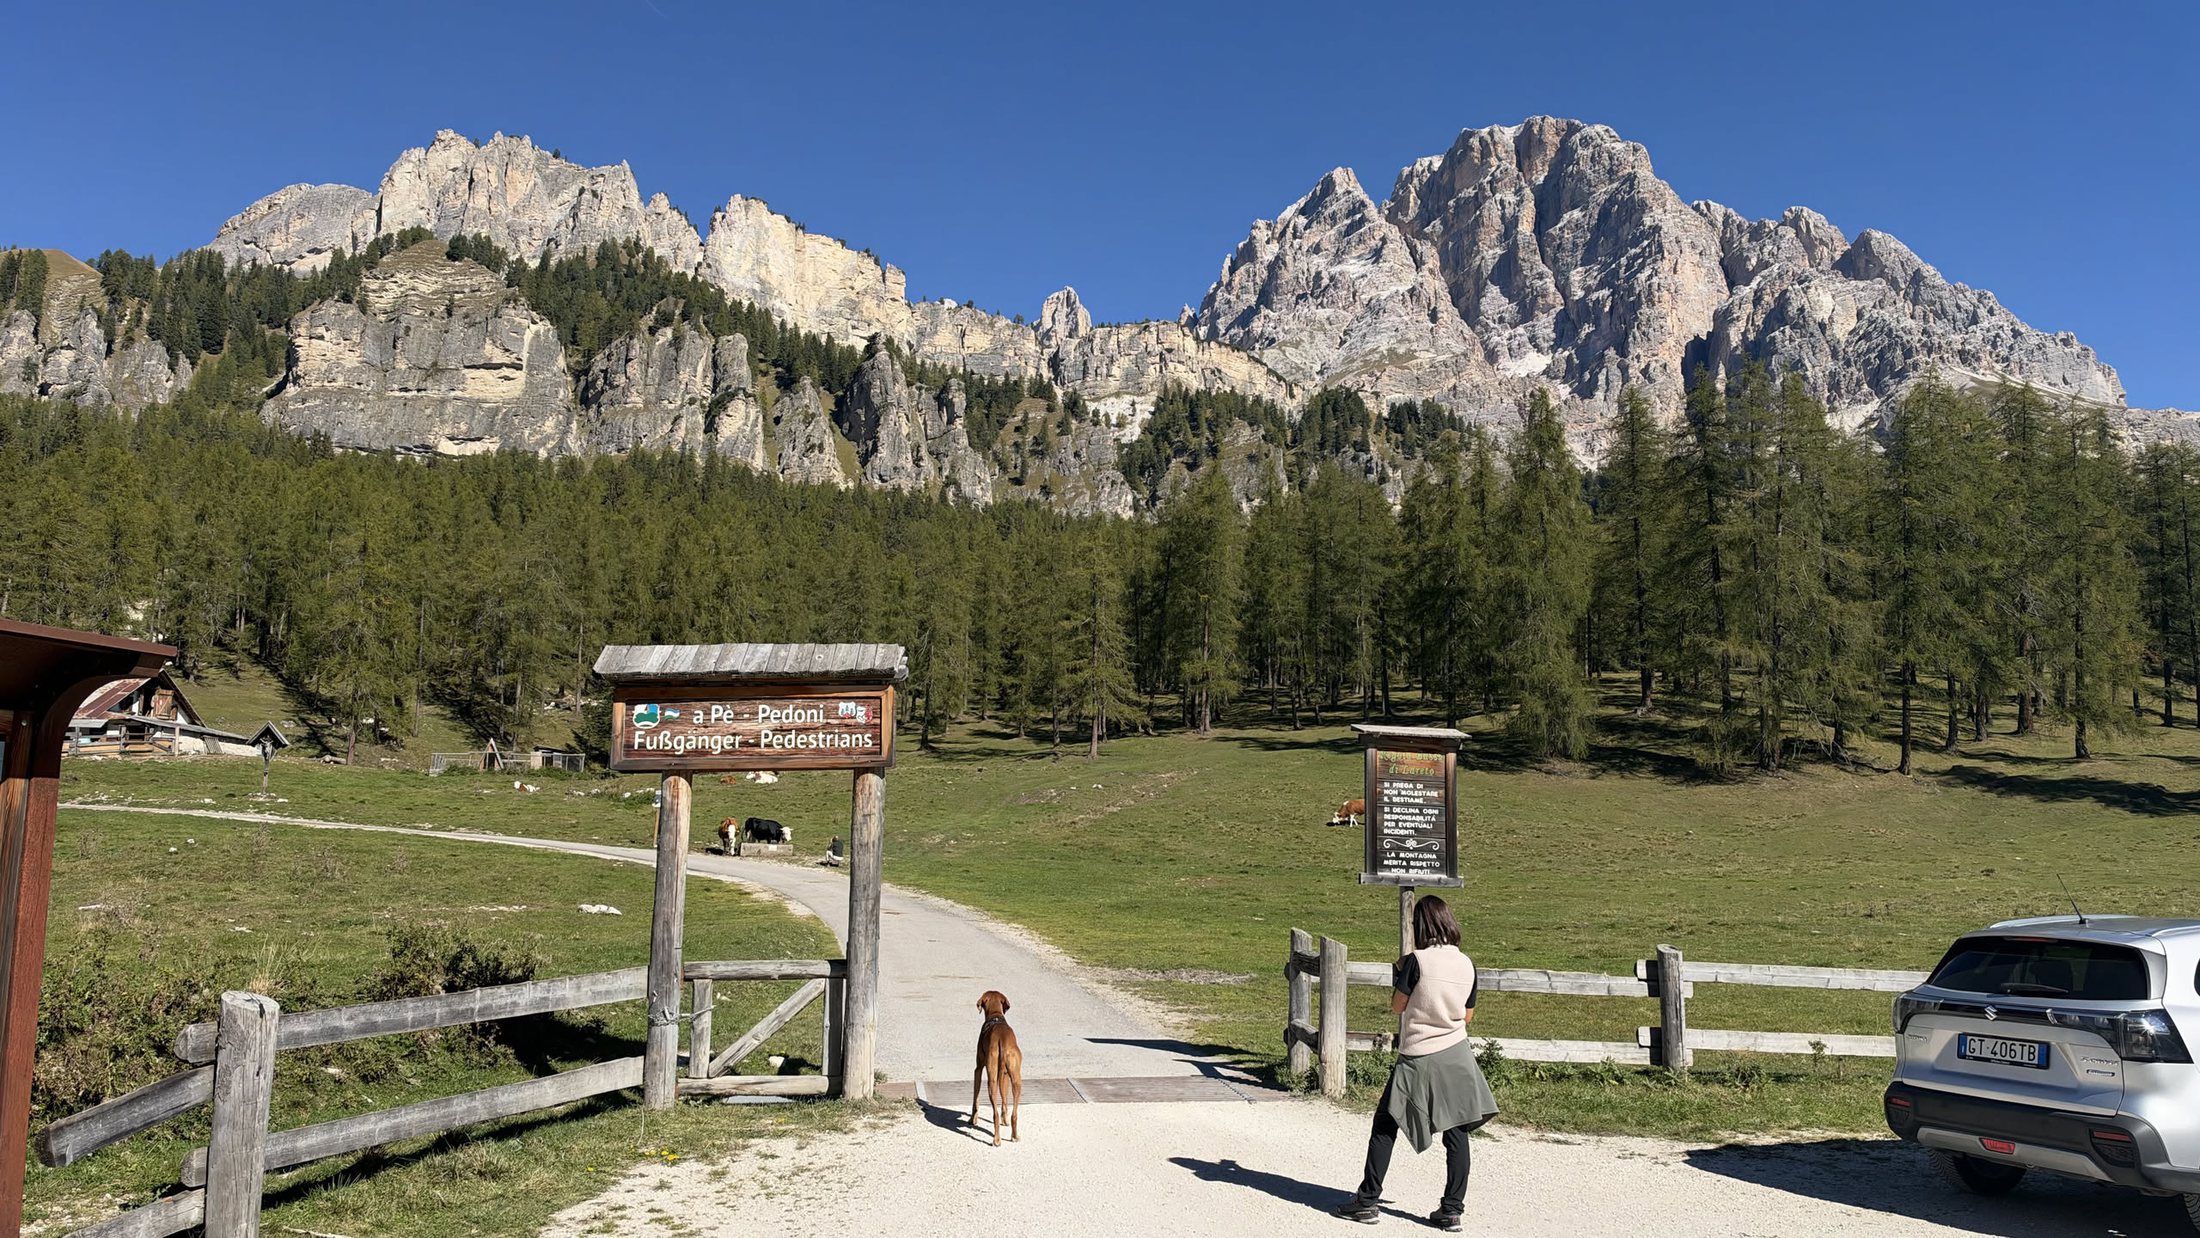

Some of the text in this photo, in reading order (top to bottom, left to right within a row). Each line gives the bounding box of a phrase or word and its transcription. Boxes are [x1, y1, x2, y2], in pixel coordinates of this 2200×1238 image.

[692, 710, 704, 724] a
[710, 704, 734, 724] Pè
[757, 704, 824, 724] Pedoni
[633, 730, 743, 755] Fußgänger
[760, 729, 874, 750] Pedestrians
[1400, 789, 1439, 798] MOLESTARE
[1383, 820, 1433, 829] PER EVENTUALI
[1409, 860, 1440, 868] RISPETTO
[1990, 1040, 2037, 1062] 406TB
